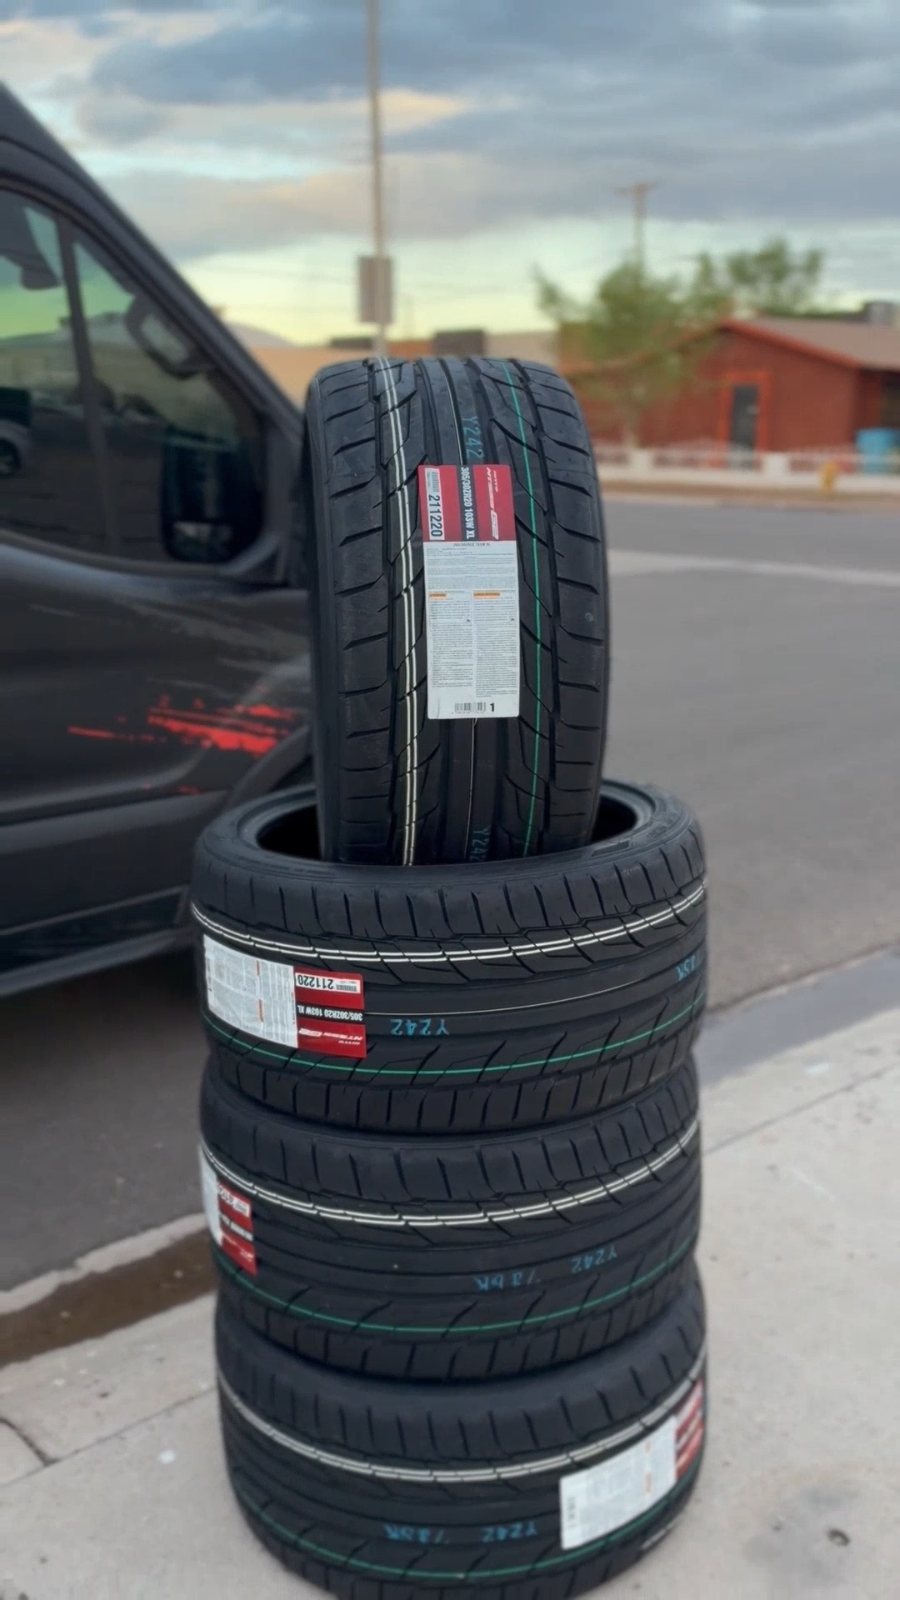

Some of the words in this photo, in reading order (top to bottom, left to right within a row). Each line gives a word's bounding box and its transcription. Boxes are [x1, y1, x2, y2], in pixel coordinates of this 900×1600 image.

[462, 415, 484, 460] Y242
[428, 494, 443, 537] 211220
[464, 508, 475, 529] 103W
[466, 530, 475, 539] XL
[490, 702, 495, 712] 1
[297, 974, 333, 990] 211220
[297, 1004, 305, 1014] XL
[390, 1018, 450, 1036] Y242
